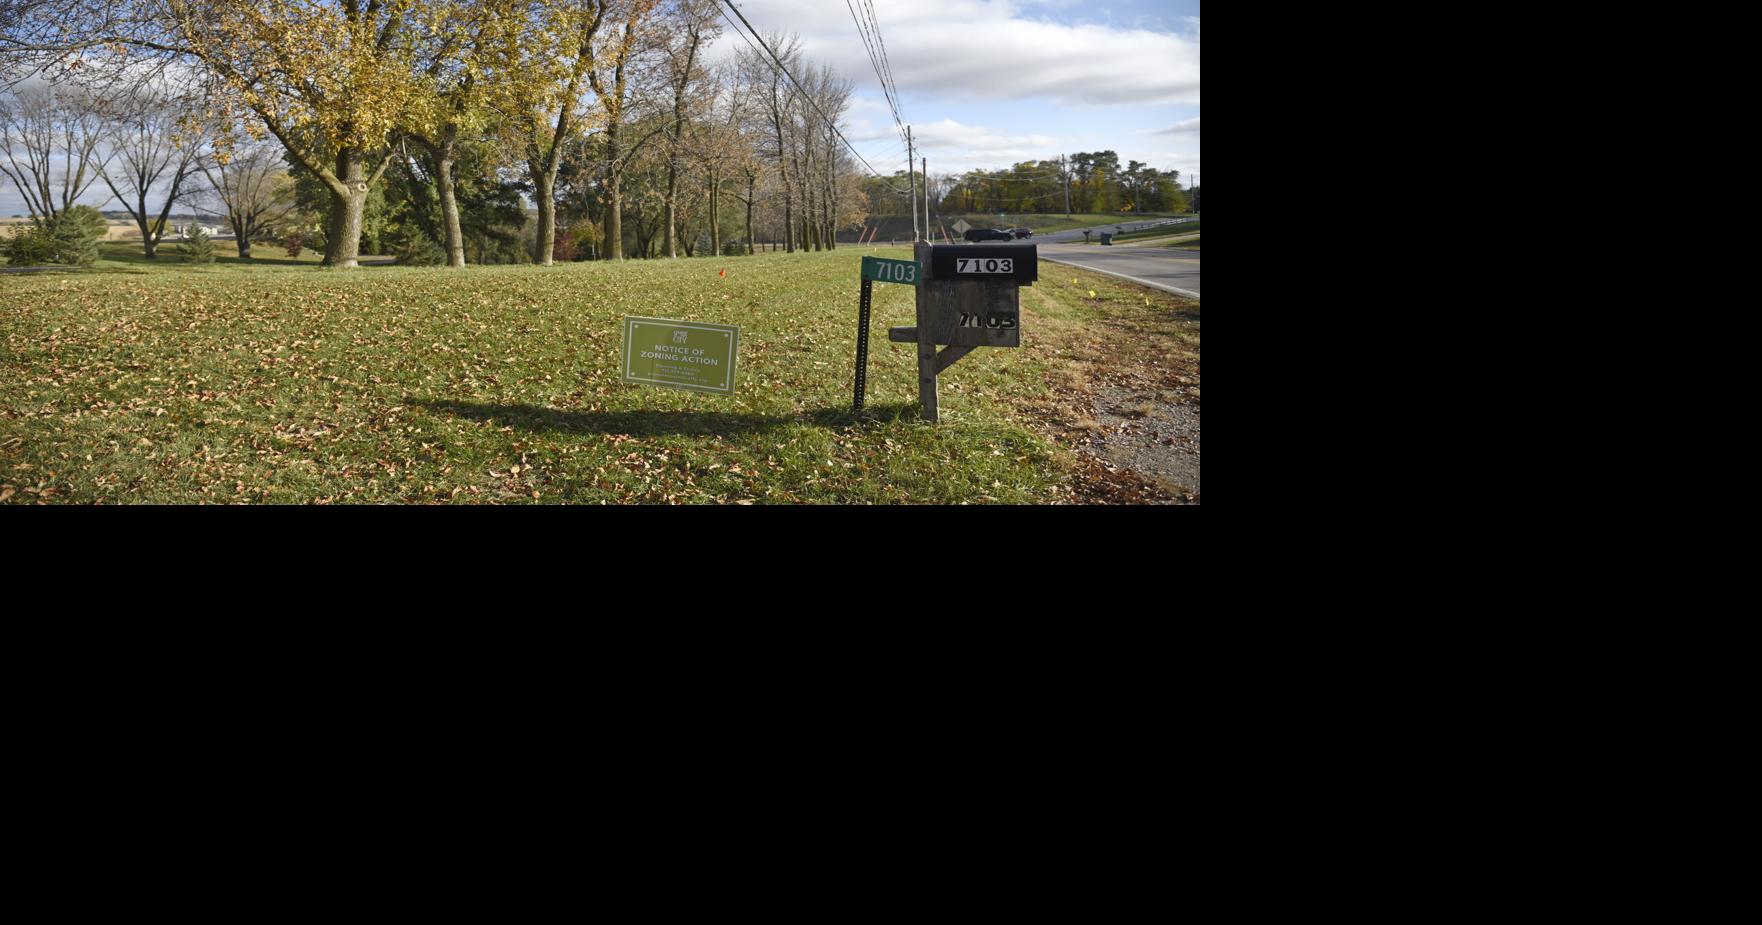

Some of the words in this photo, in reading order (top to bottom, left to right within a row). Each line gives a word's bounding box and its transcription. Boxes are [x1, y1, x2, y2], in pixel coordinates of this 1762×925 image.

[876, 262, 916, 282] 7103
[958, 259, 1012, 272] 7103
[959, 312, 1016, 328] 7103
[640, 350, 678, 361] ZONING
[681, 355, 718, 366] ACTION
[655, 344, 689, 354] NOTICE
[692, 348, 705, 356] OF
